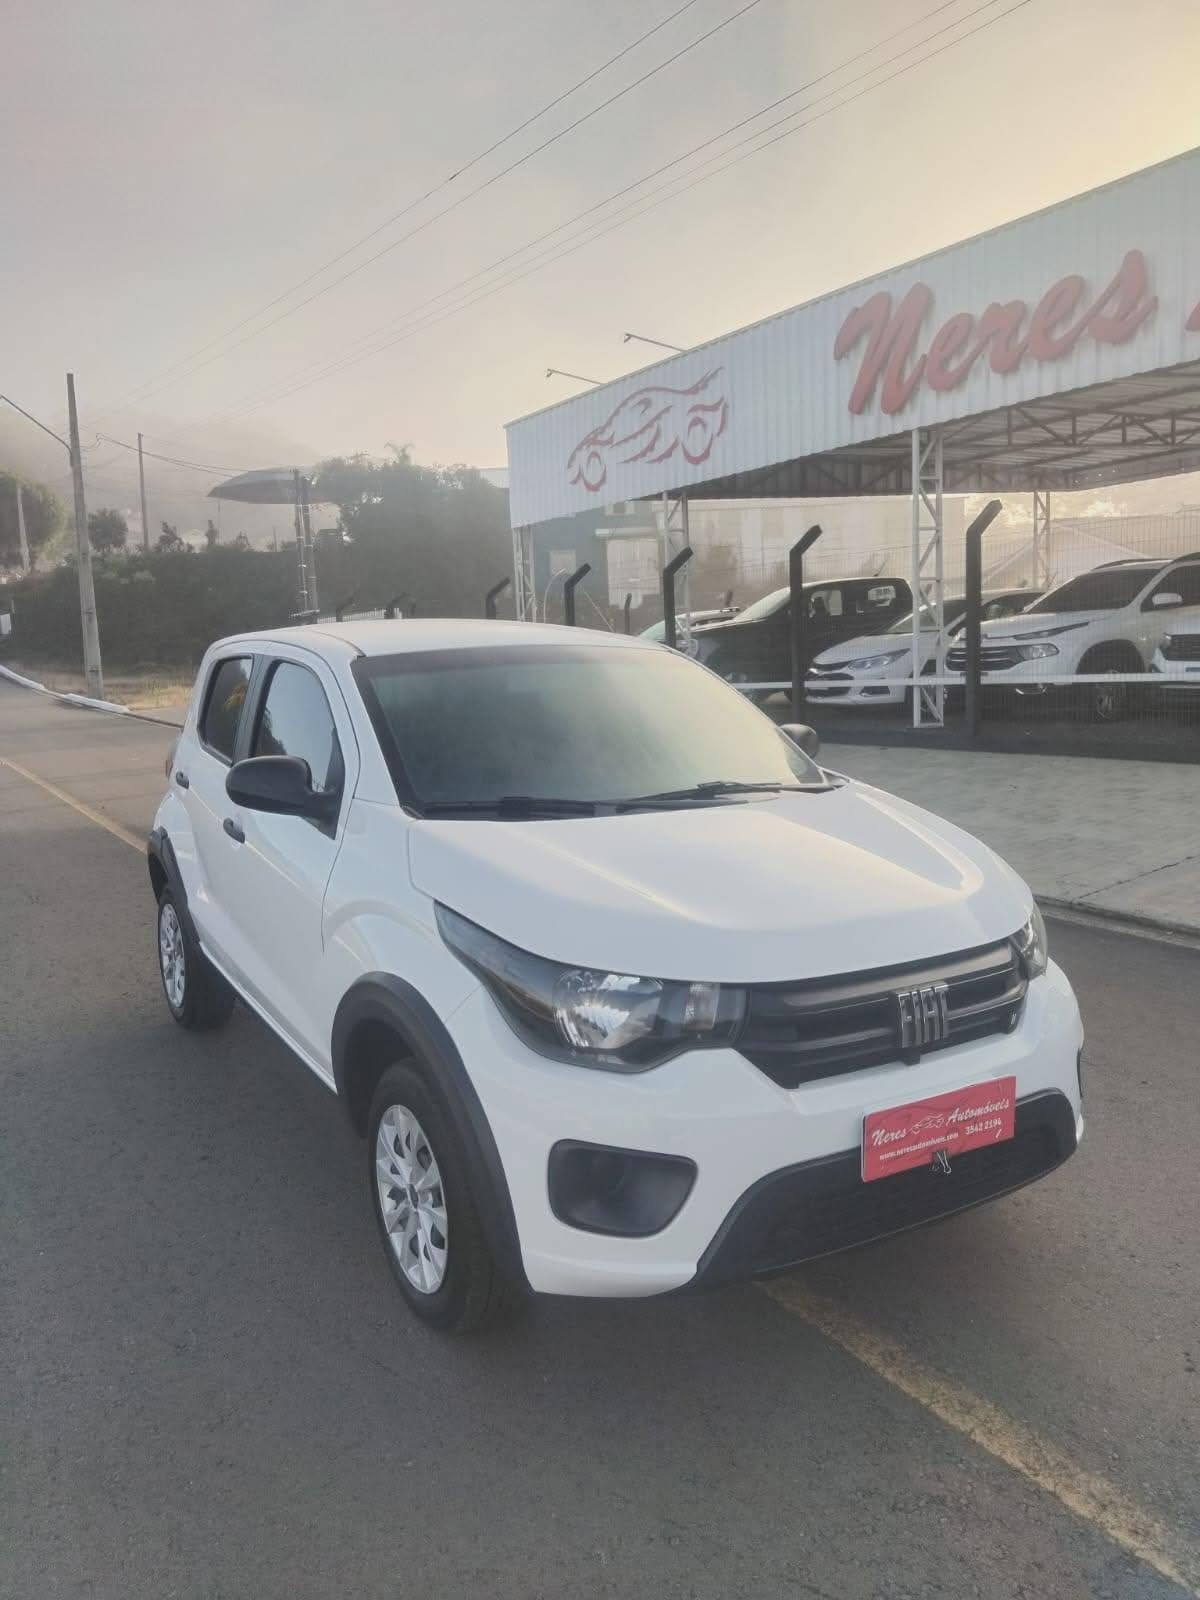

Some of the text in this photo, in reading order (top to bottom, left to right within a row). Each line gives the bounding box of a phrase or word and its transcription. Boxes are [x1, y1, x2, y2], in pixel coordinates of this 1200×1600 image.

[833, 249, 1158, 415] Neres
[872, 1099, 1009, 1146] Neres Automóveis
